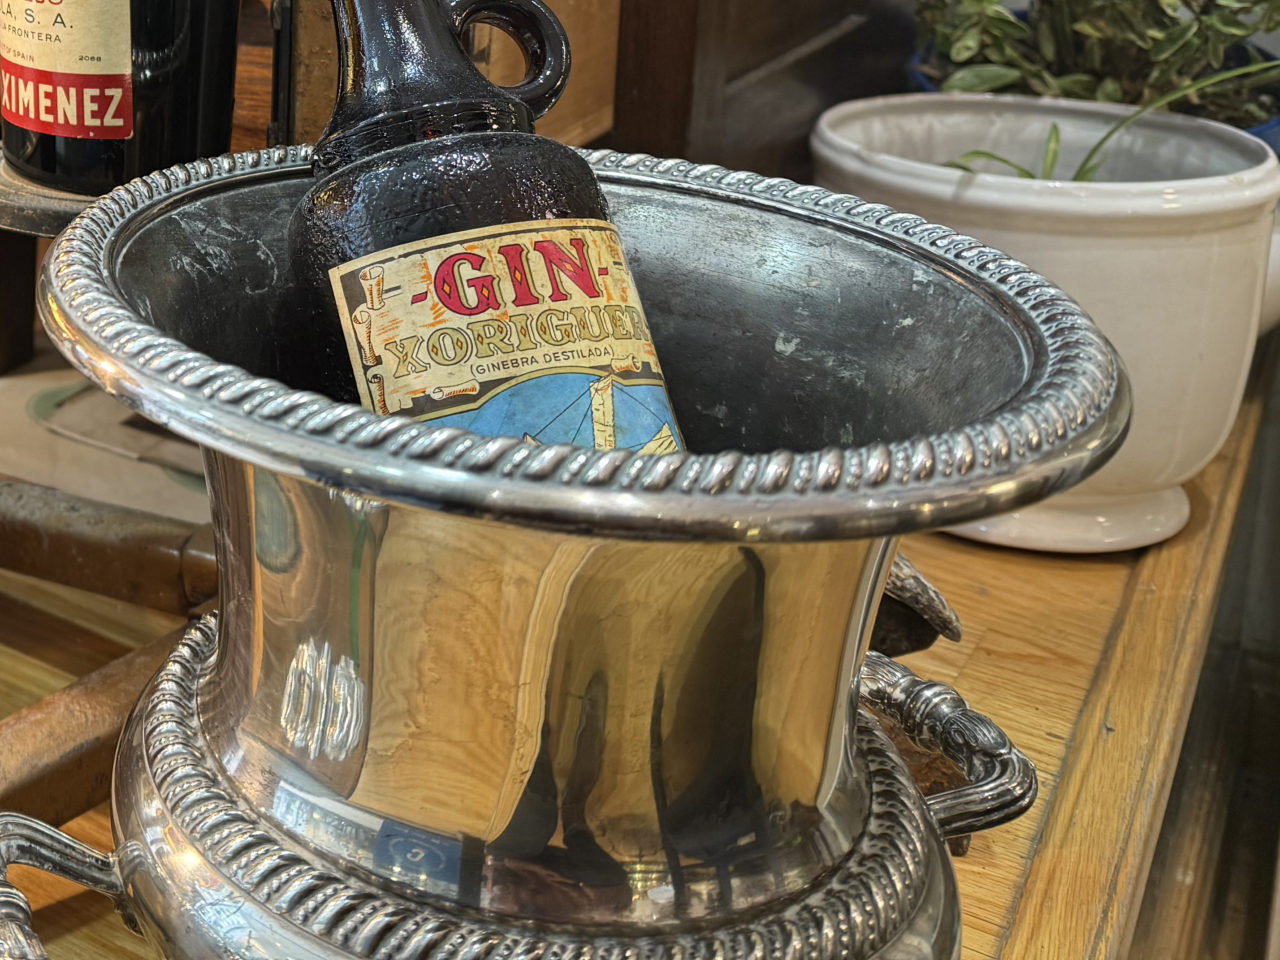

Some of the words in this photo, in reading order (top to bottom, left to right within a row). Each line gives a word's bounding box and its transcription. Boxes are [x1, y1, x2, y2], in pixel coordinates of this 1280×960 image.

[24, 7, 42, 25] S.
[52, 12, 74, 29] A.
[7, 24, 62, 44] FRONTERA
[12, 48, 35, 64] SPAIN
[1, 68, 124, 127] XIMENEZ
[384, 304, 650, 379] XORIGUER
